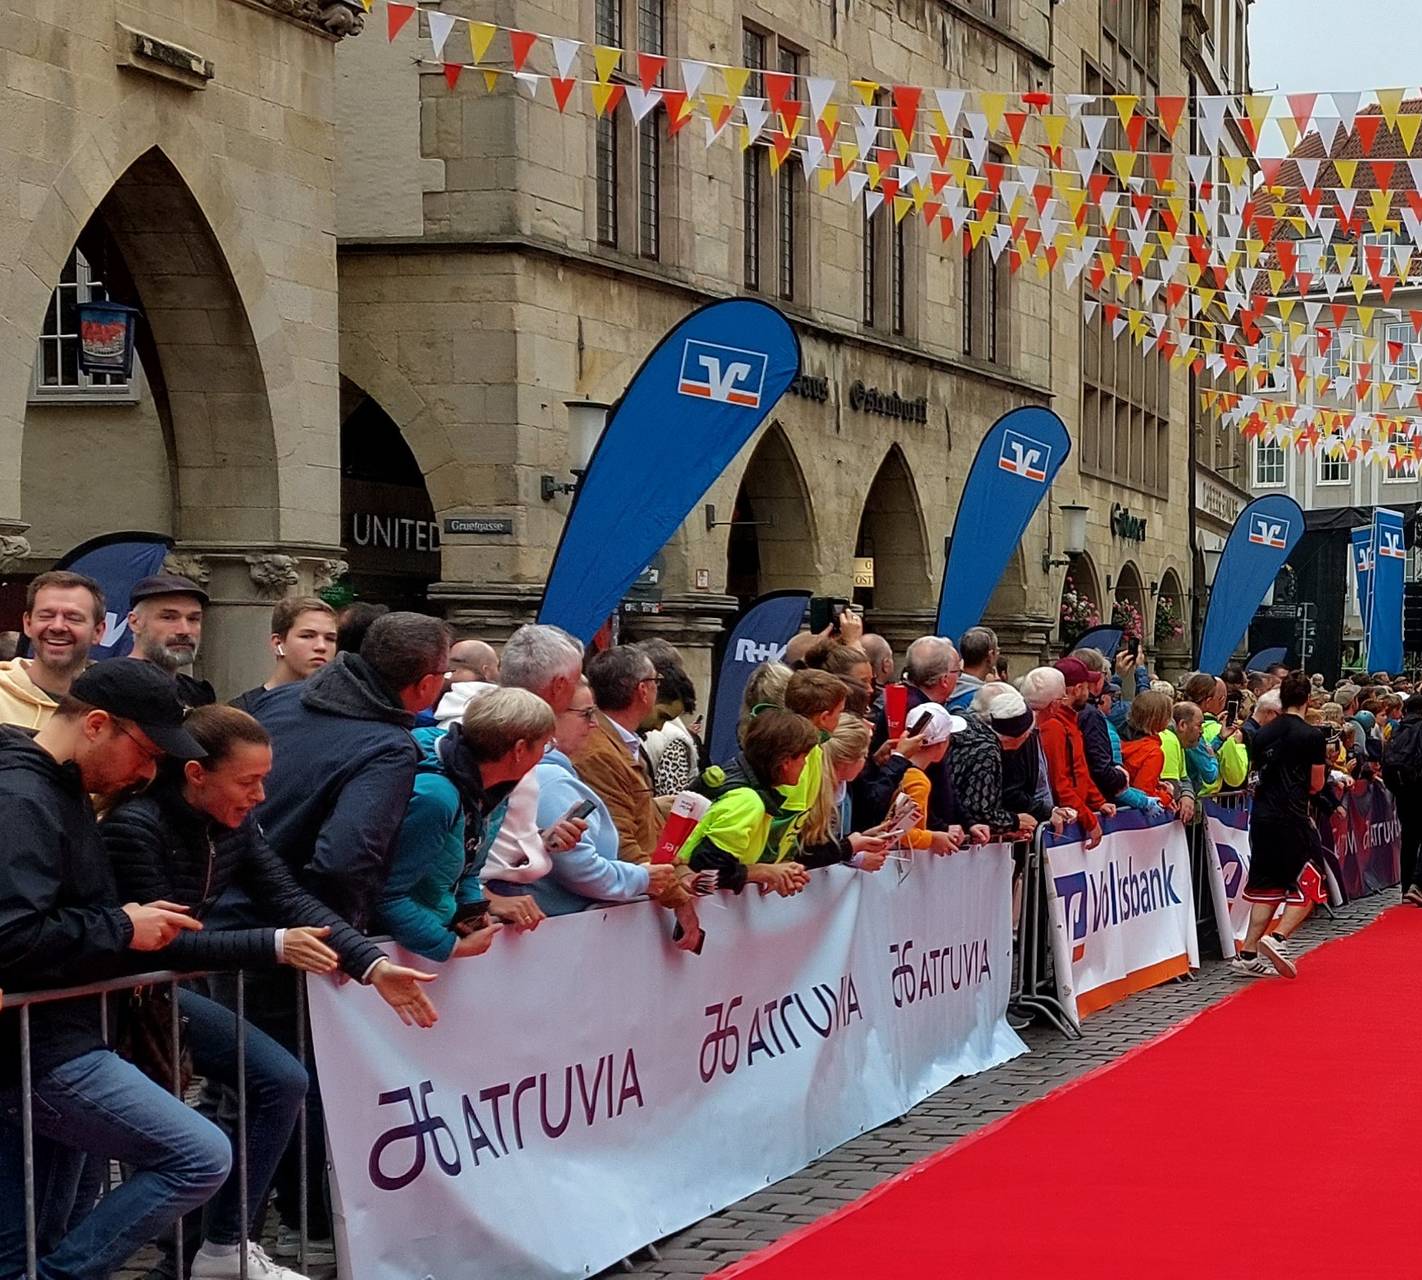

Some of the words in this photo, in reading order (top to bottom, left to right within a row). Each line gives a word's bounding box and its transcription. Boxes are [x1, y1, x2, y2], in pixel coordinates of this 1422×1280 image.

[353, 513, 440, 551] UNITED
[919, 938, 992, 1001] ATRUVIA
[461, 1046, 645, 1167] ATRUVIA
